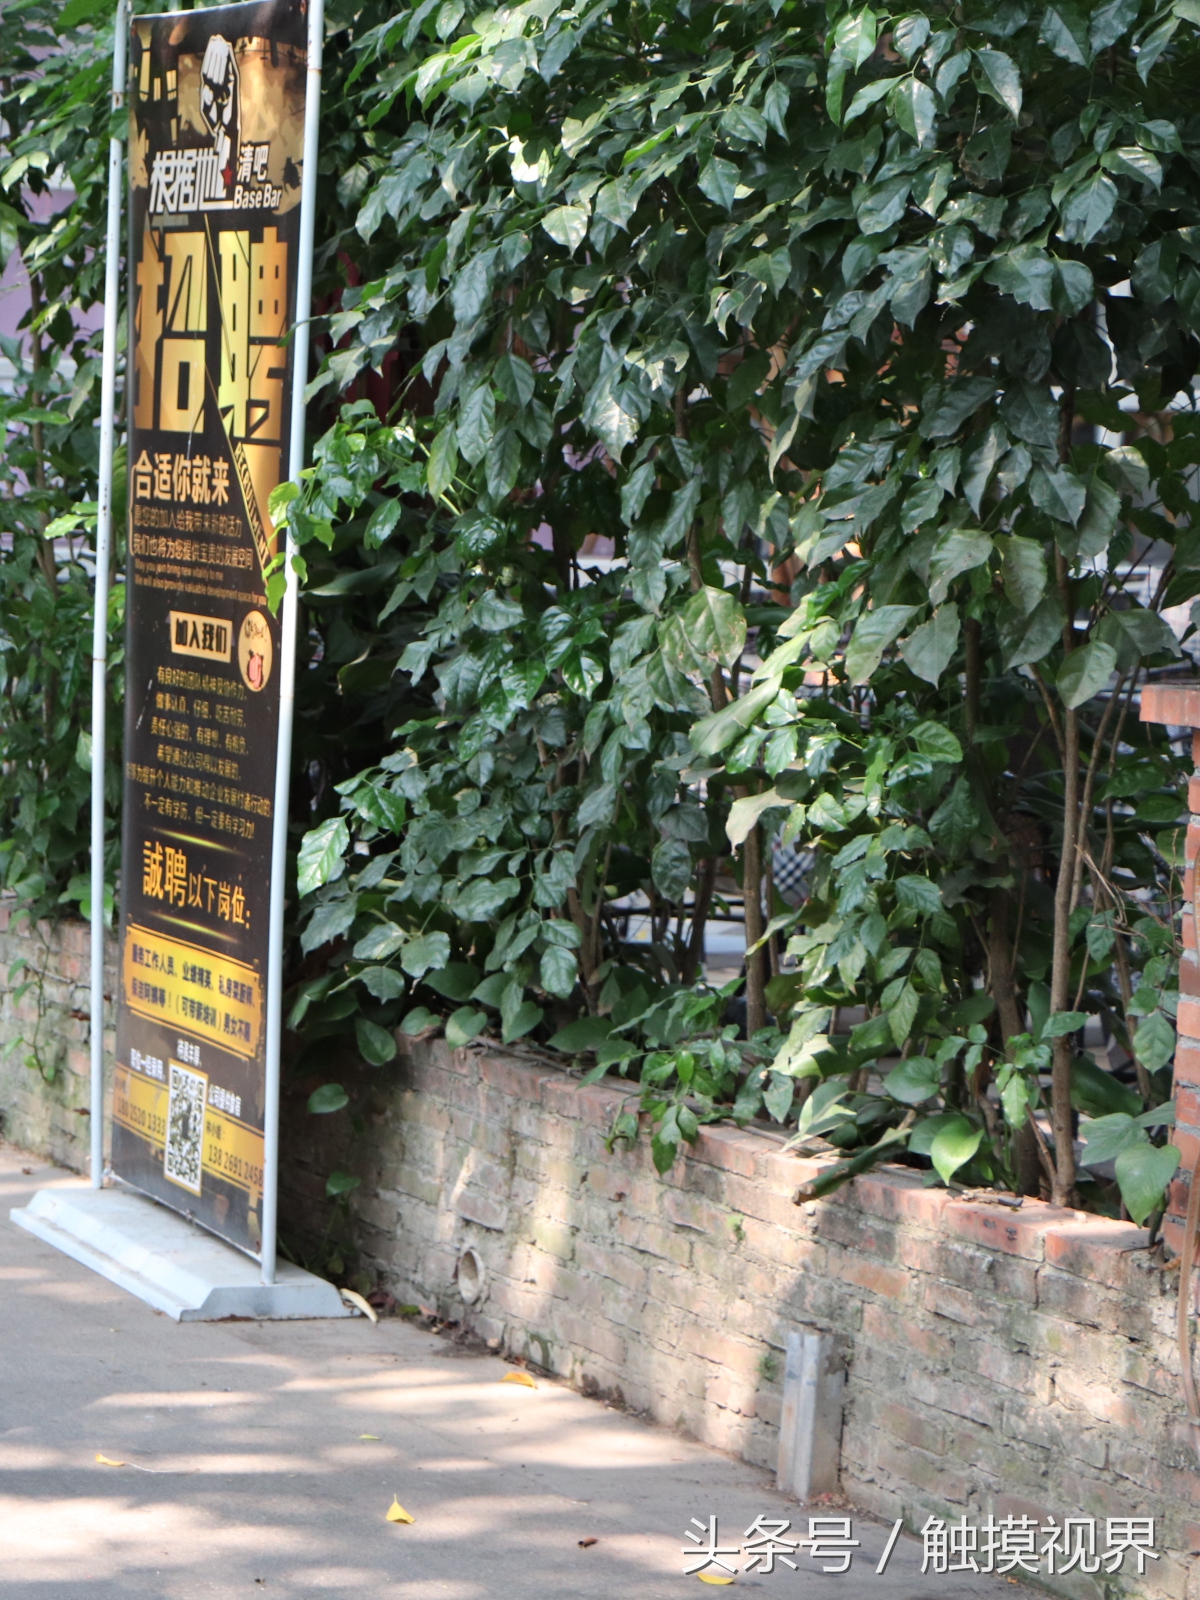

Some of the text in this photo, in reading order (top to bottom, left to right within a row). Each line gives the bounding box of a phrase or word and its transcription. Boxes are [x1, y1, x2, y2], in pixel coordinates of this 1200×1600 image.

[149, 147, 233, 213] 根据地
[237, 144, 270, 182] 清吧
[234, 184, 282, 209] Base Bar
[134, 226, 288, 440] 招聘
[135, 450, 230, 506] 合适你就来
[175, 618, 227, 654] 加入我们
[208, 1144, 223, 1165] 138
